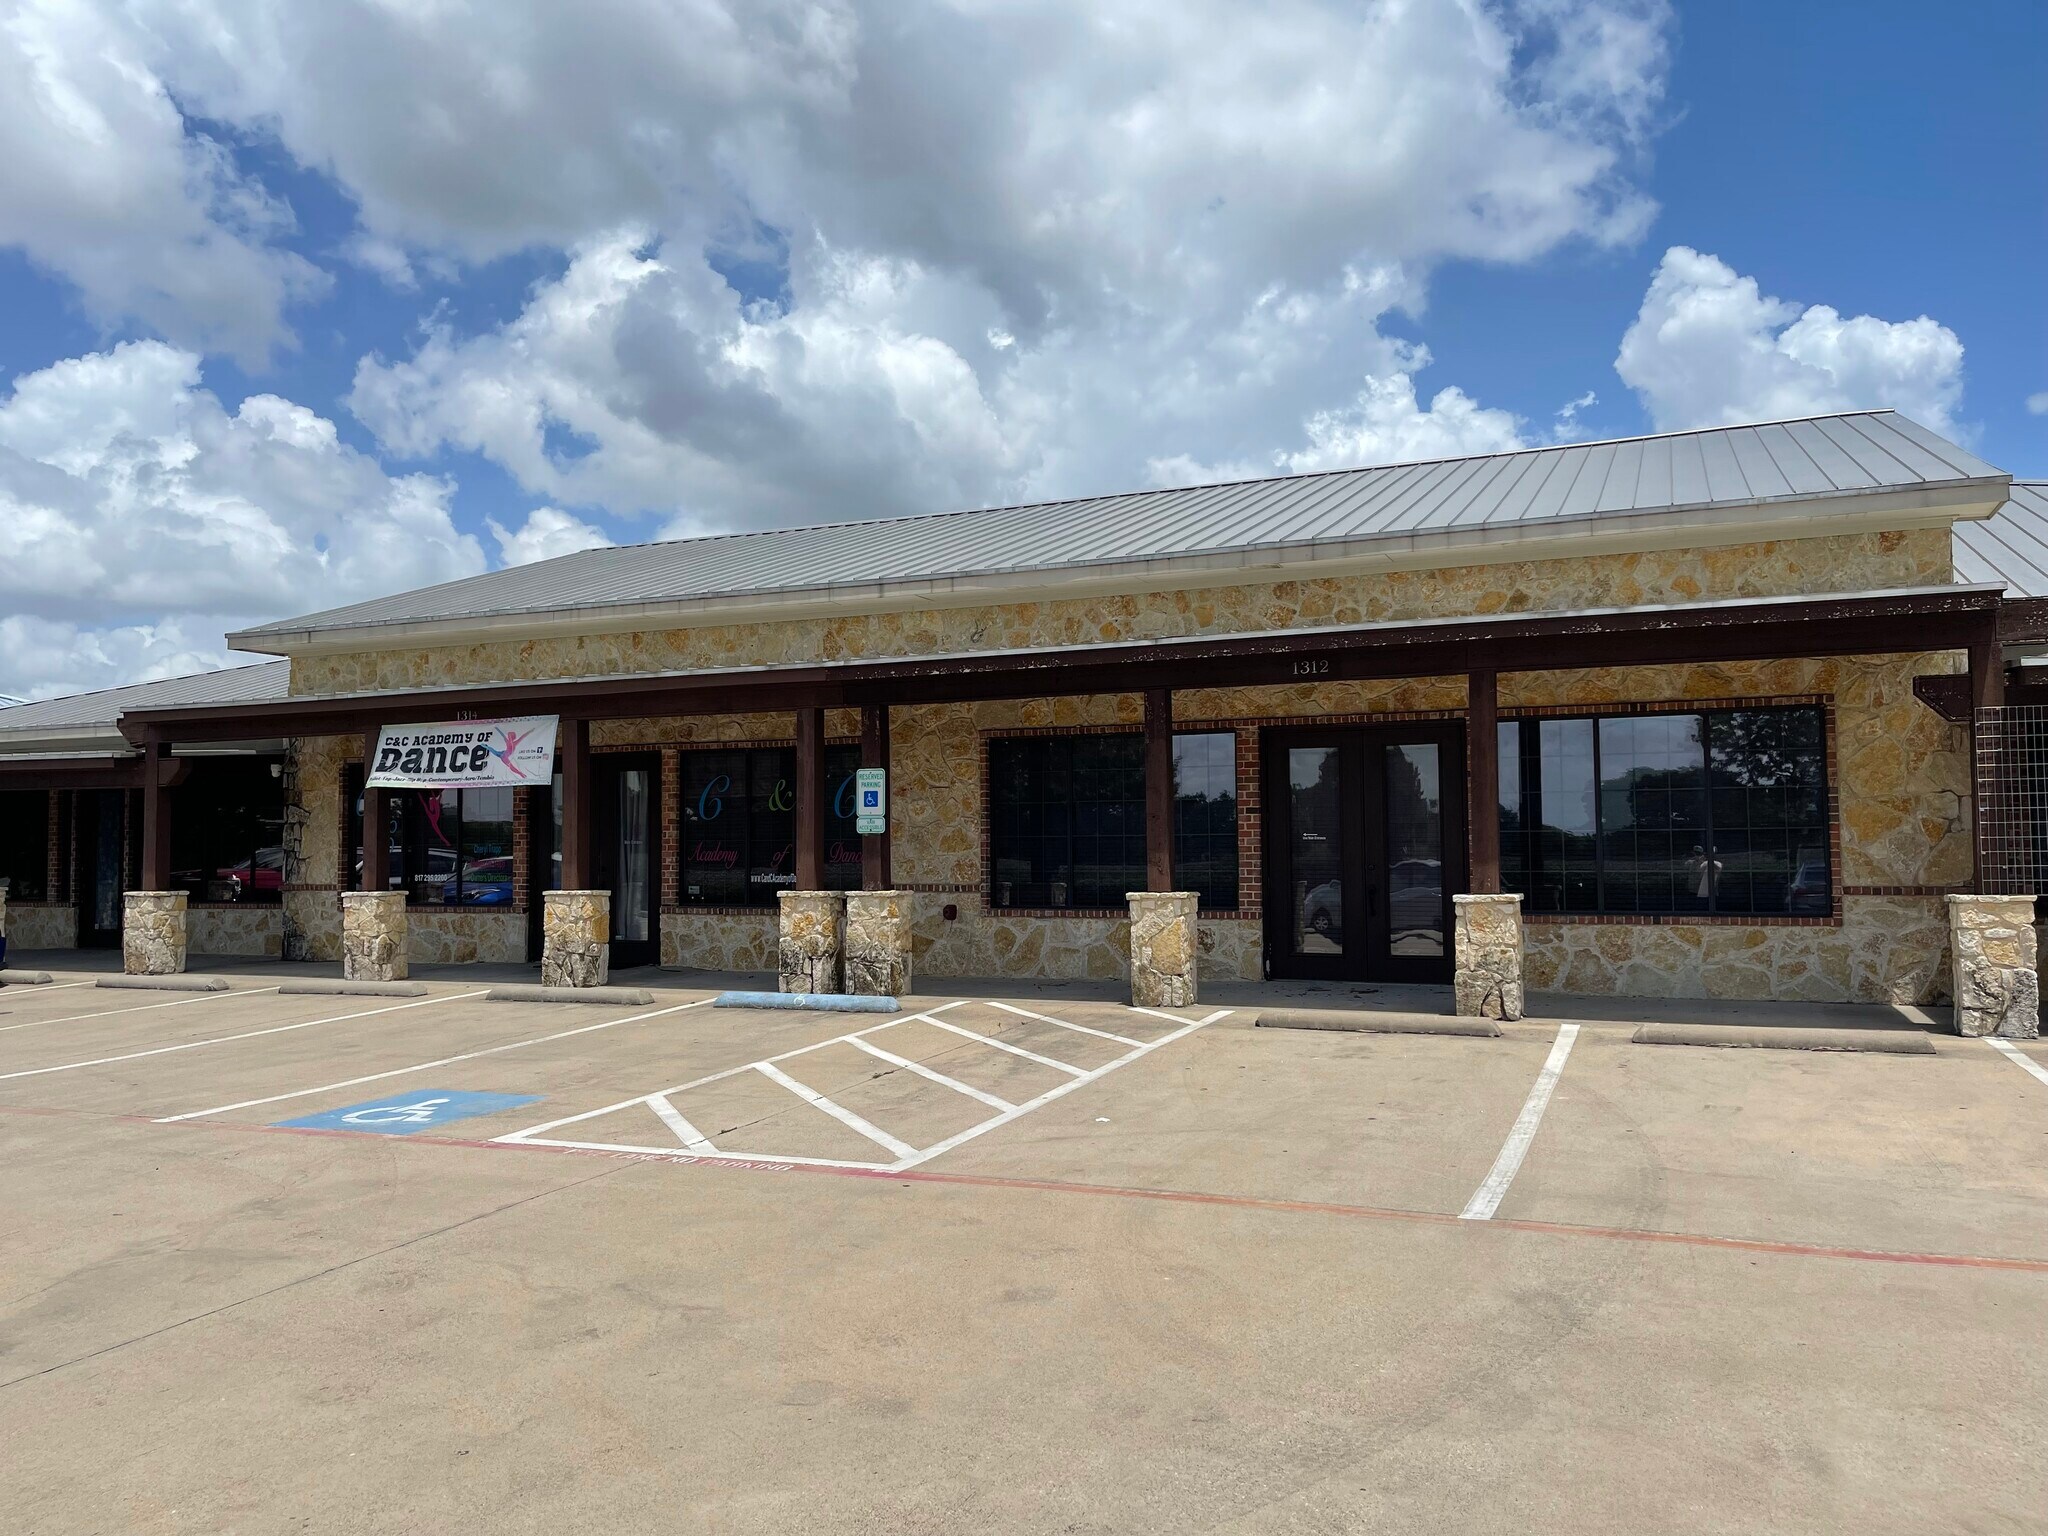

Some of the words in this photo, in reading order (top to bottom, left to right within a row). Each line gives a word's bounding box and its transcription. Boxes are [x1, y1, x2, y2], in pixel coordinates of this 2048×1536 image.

[1293, 660, 1329, 675] 1312
[385, 736, 410, 747] C&C
[477, 731, 493, 742] OF
[699, 774, 731, 820] C
[768, 779, 796, 812] &
[688, 840, 739, 869] Academy
[770, 844, 792, 868] of
[830, 841, 863, 864] Danc
[414, 874, 423, 882] 817
